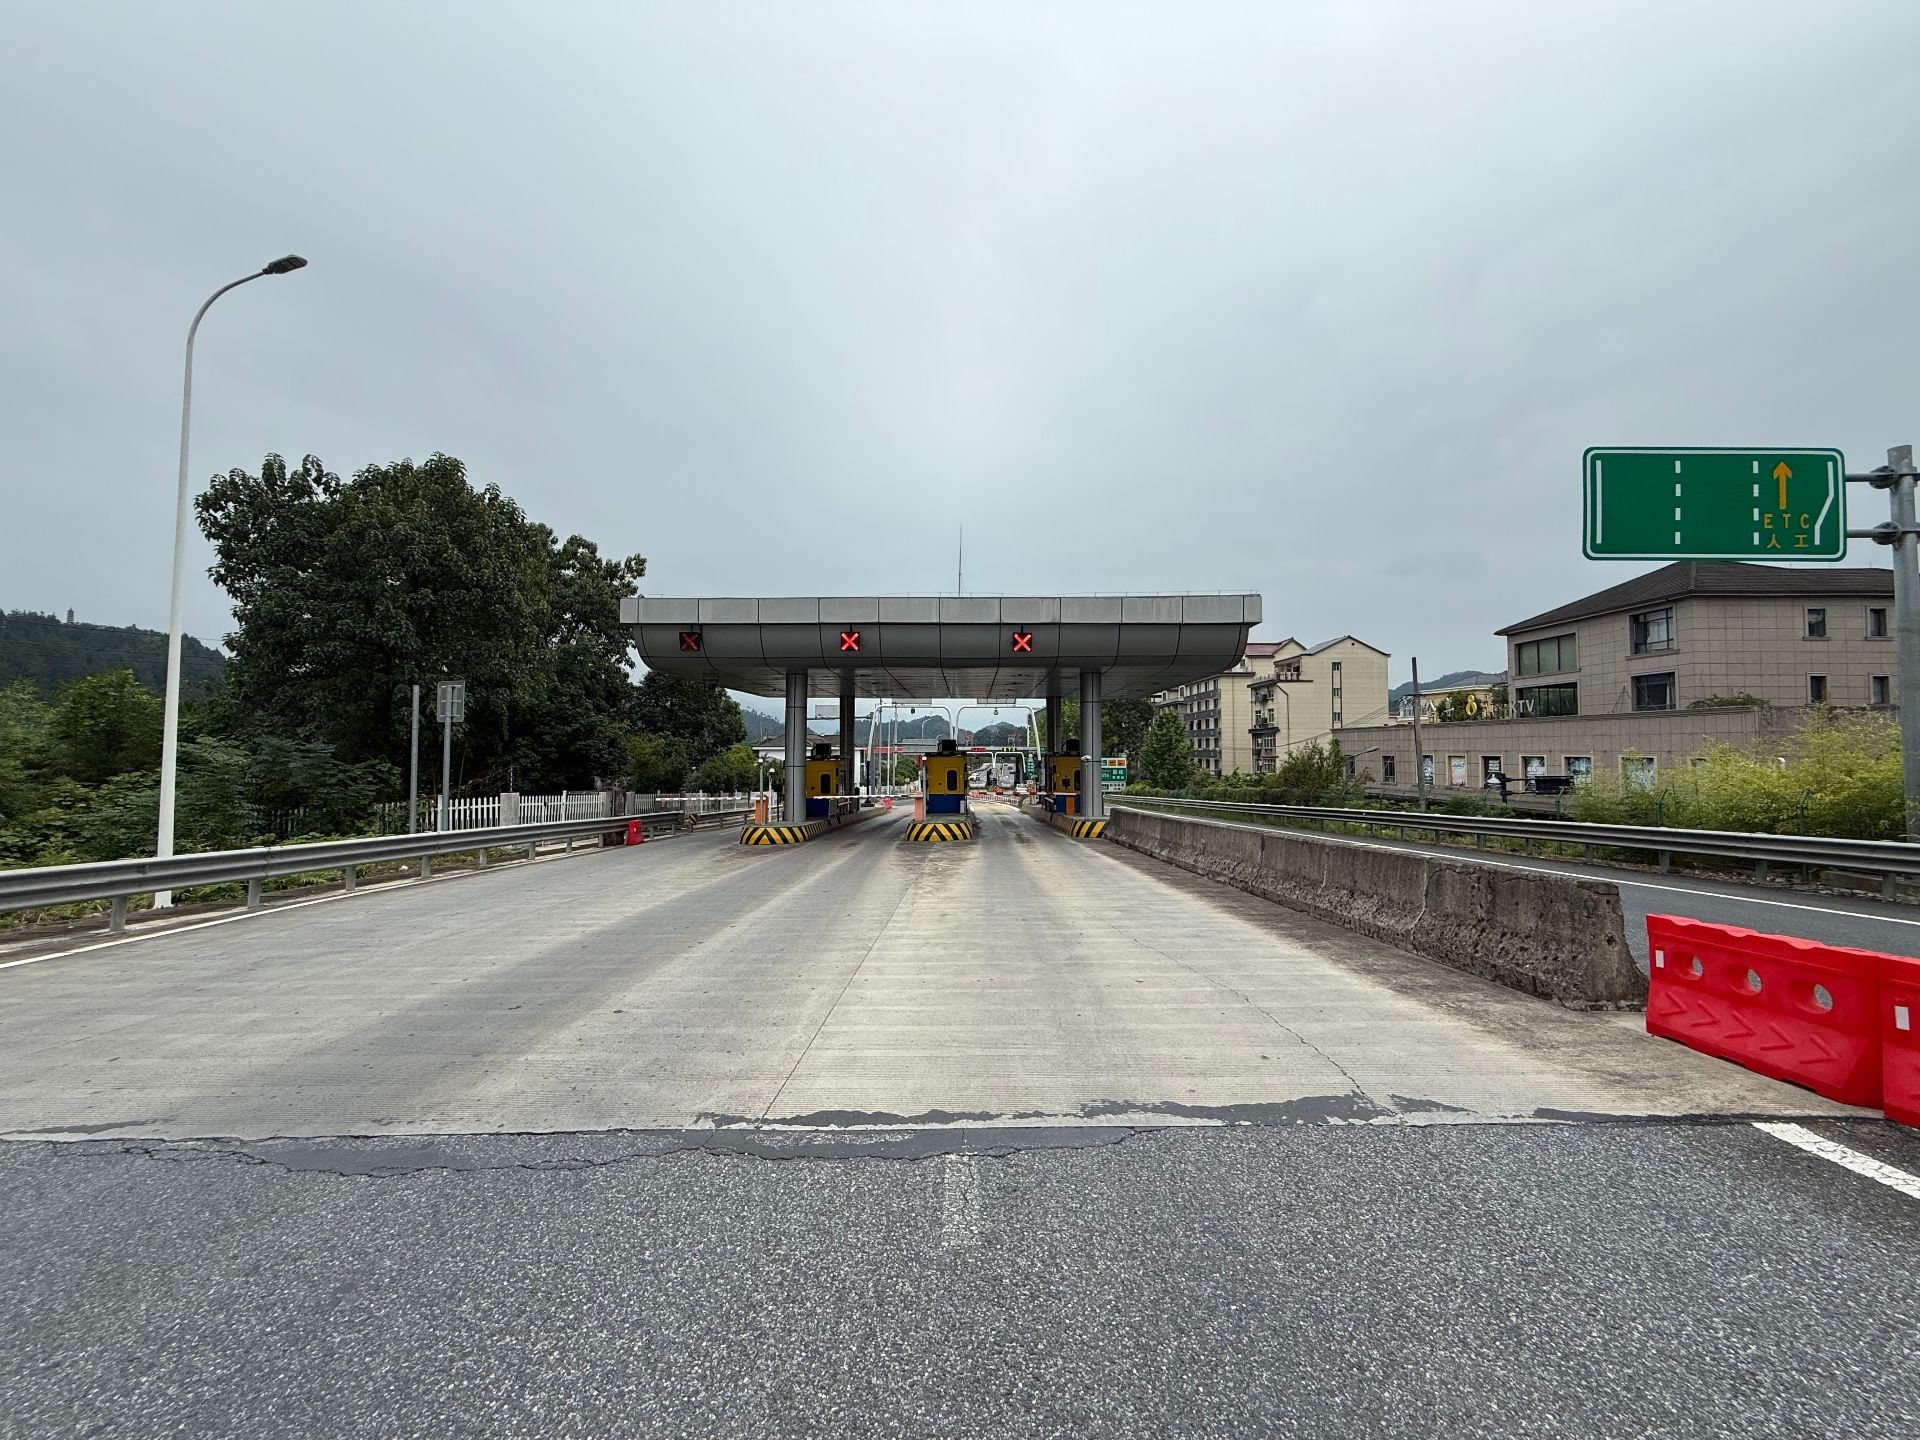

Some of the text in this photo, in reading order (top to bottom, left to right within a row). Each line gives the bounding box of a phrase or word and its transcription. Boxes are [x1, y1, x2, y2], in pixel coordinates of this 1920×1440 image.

[1763, 513, 1810, 529] ETC
[1766, 533, 1809, 549] 人工
[1509, 699, 1535, 715] KTV
